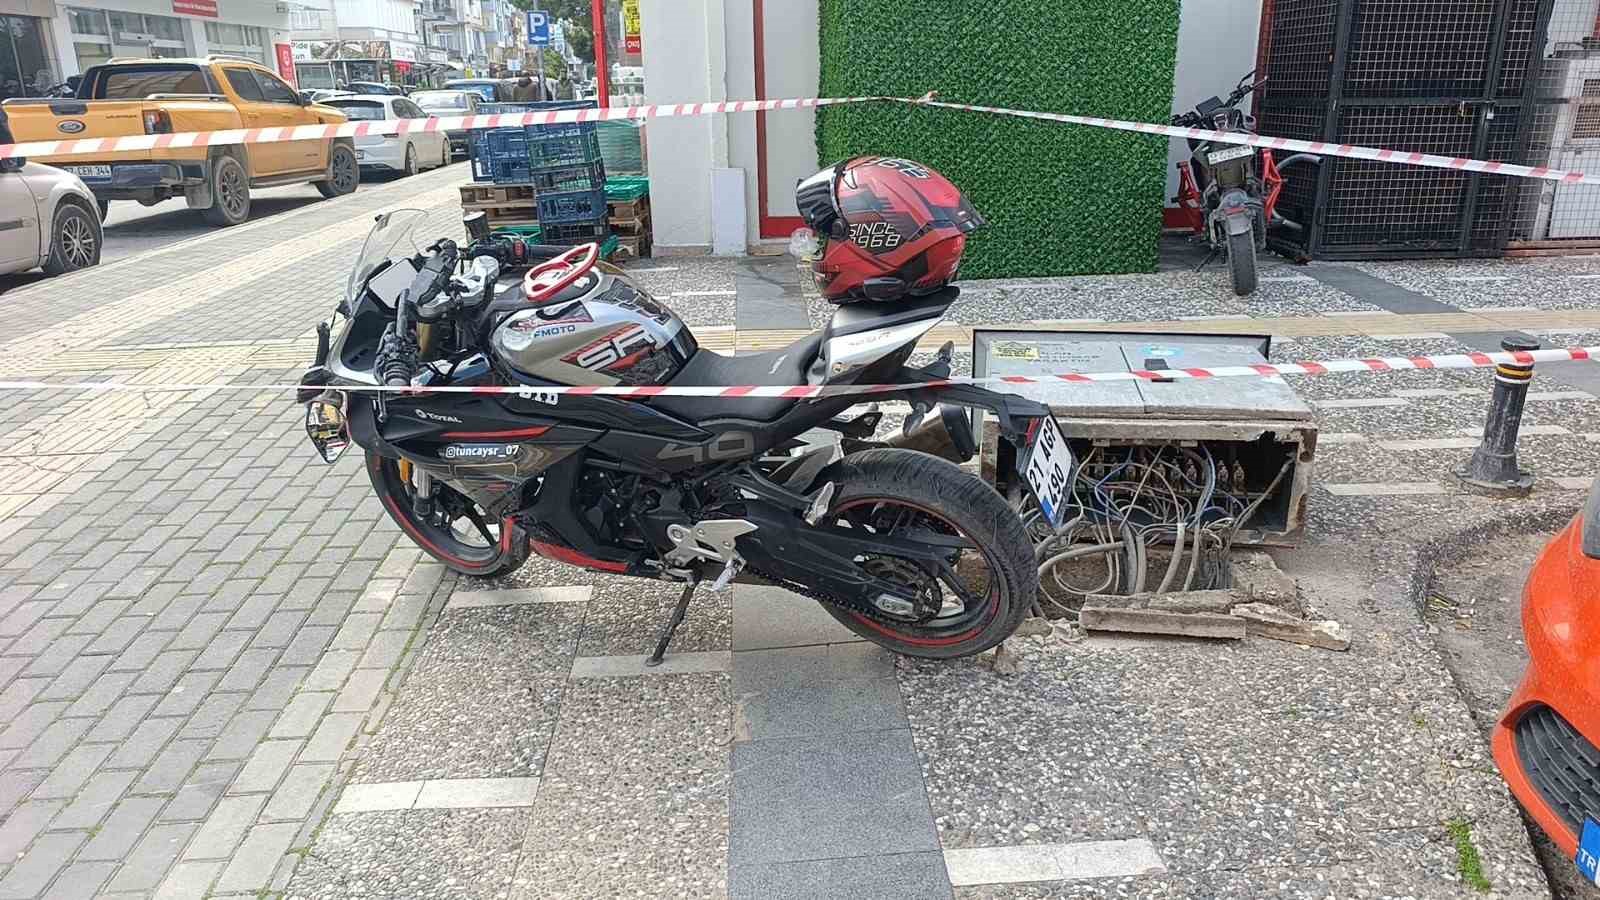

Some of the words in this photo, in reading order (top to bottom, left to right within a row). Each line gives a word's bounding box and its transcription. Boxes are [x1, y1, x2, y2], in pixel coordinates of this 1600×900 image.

[529, 13, 545, 33] P
[849, 222, 897, 236] SINCE
[850, 234, 901, 249] 1968
[533, 324, 576, 338] FMOTO
[1029, 458, 1044, 494] 21
[1047, 462, 1065, 506] 490
[1580, 847, 1597, 873] TR
